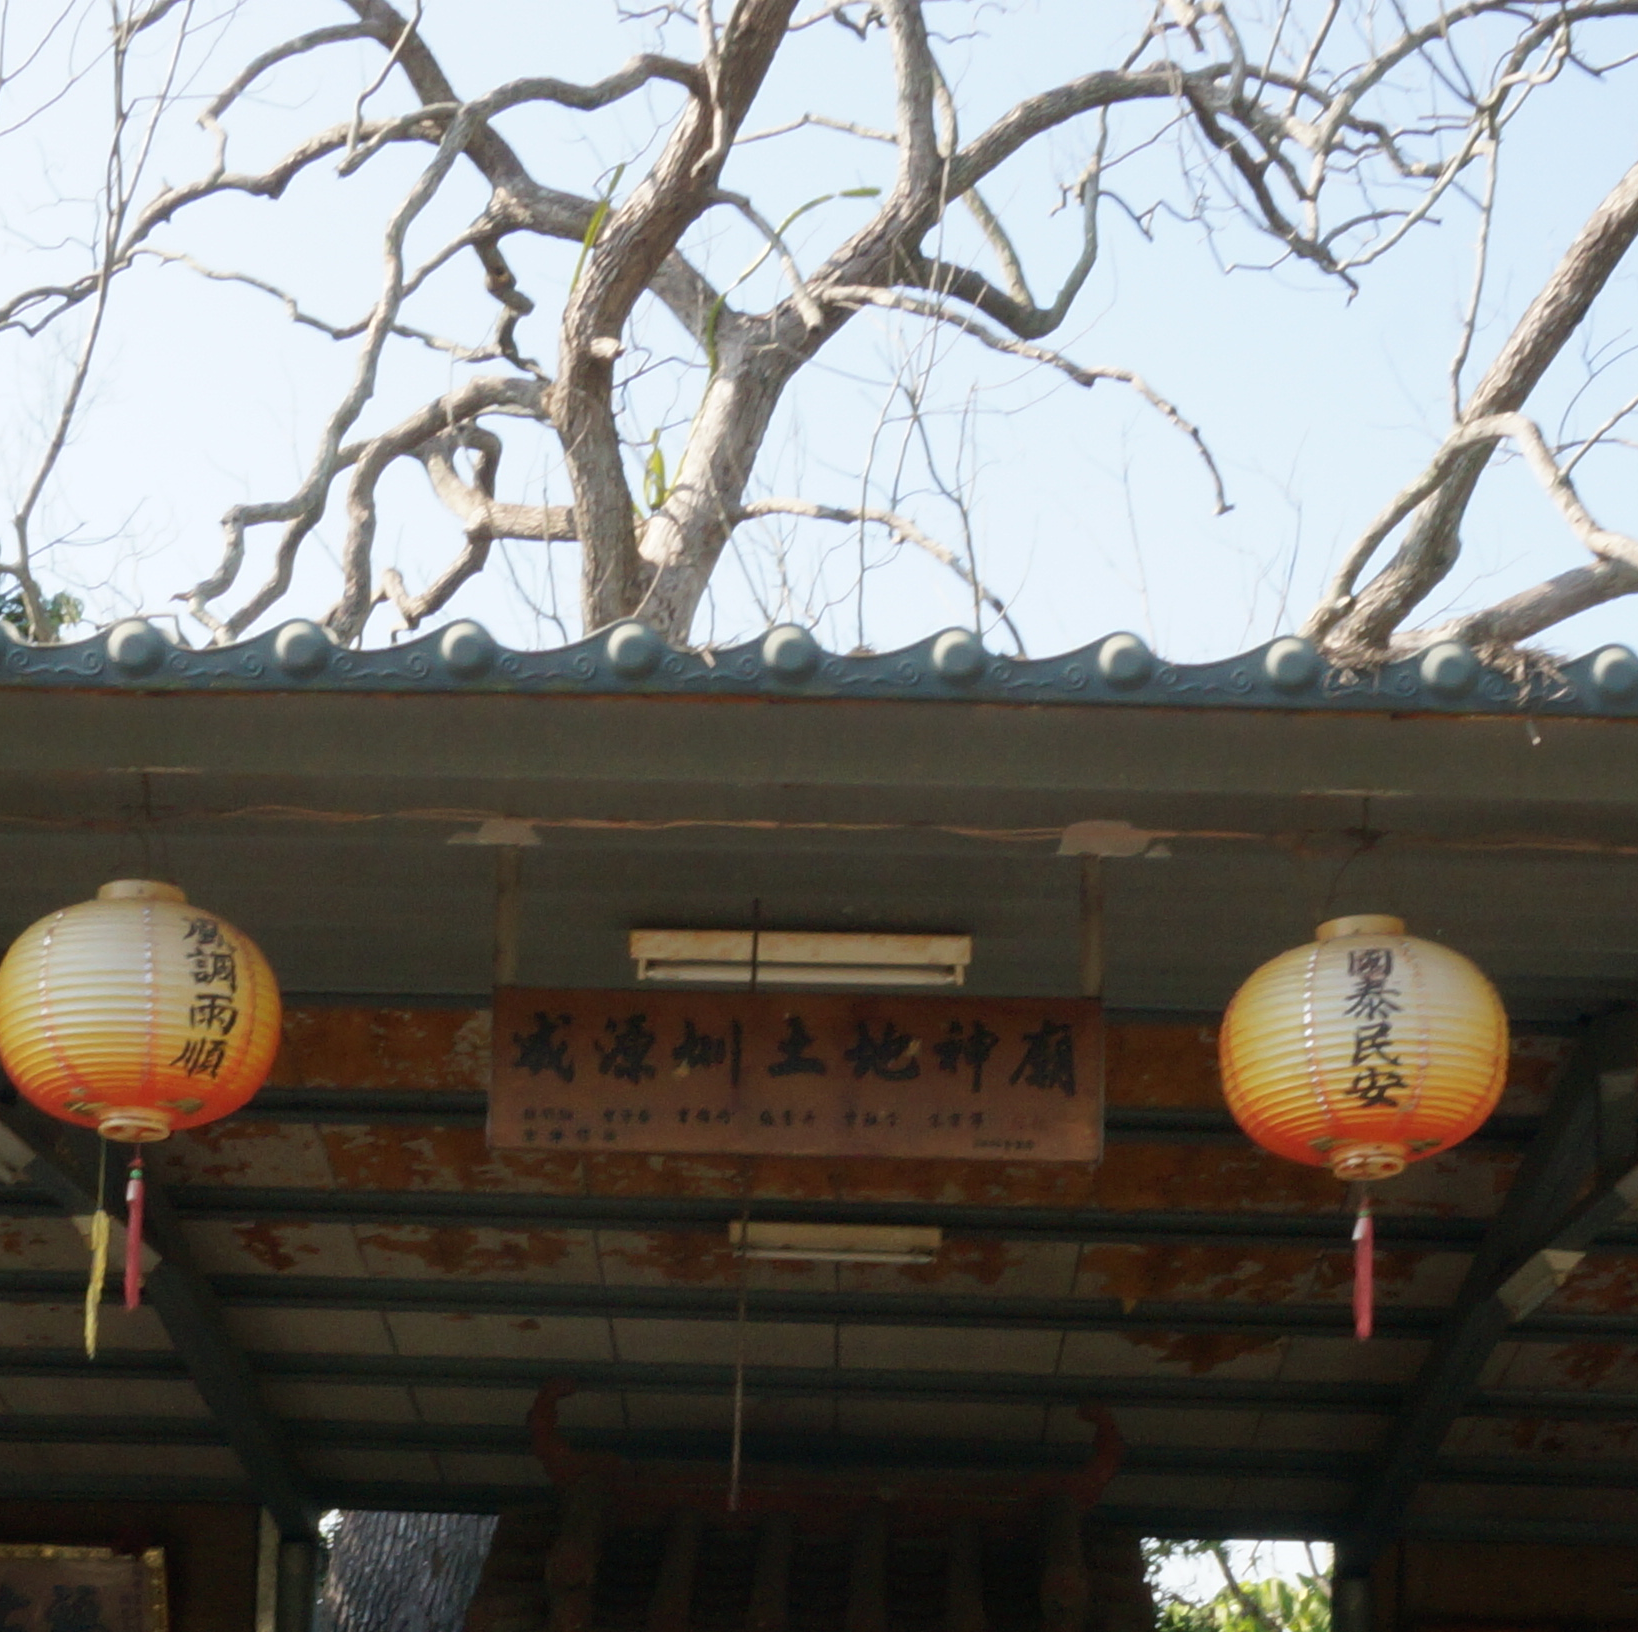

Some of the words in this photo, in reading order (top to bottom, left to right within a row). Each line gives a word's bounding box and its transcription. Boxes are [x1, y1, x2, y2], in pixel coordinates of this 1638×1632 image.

[170, 914, 241, 1080] 風調雨順
[1343, 947, 1407, 1110] 國泰民安
